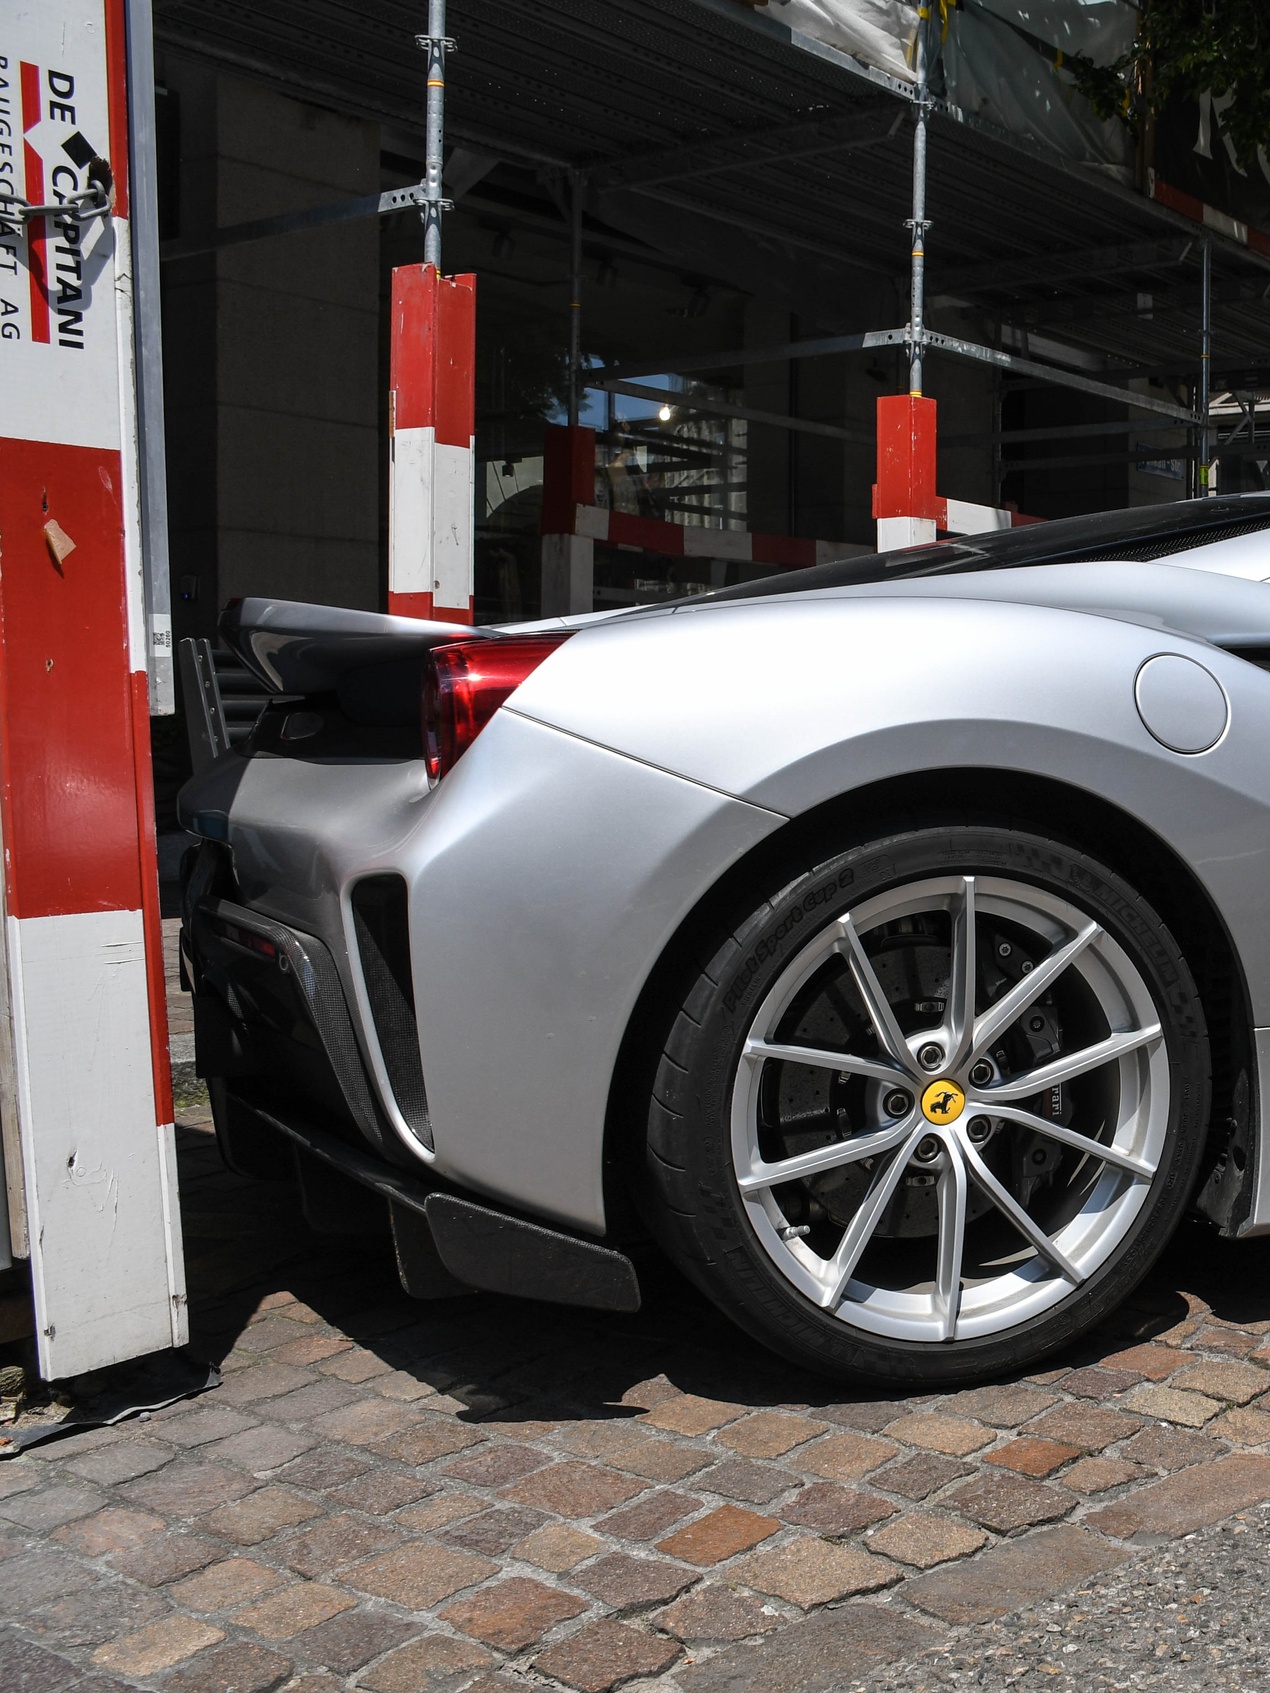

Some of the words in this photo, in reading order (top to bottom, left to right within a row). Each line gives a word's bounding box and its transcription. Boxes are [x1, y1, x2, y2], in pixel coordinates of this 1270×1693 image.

[48, 68, 76, 126] DE
[1, 298, 20, 340] AG
[723, 956, 760, 1014] Pilot
[755, 905, 804, 964] Sport
[802, 882, 838, 912] Cup
[838, 867, 854, 888] 2
[1095, 883, 1180, 985] MICHELIN
[1051, 1083, 1063, 1116] rari
